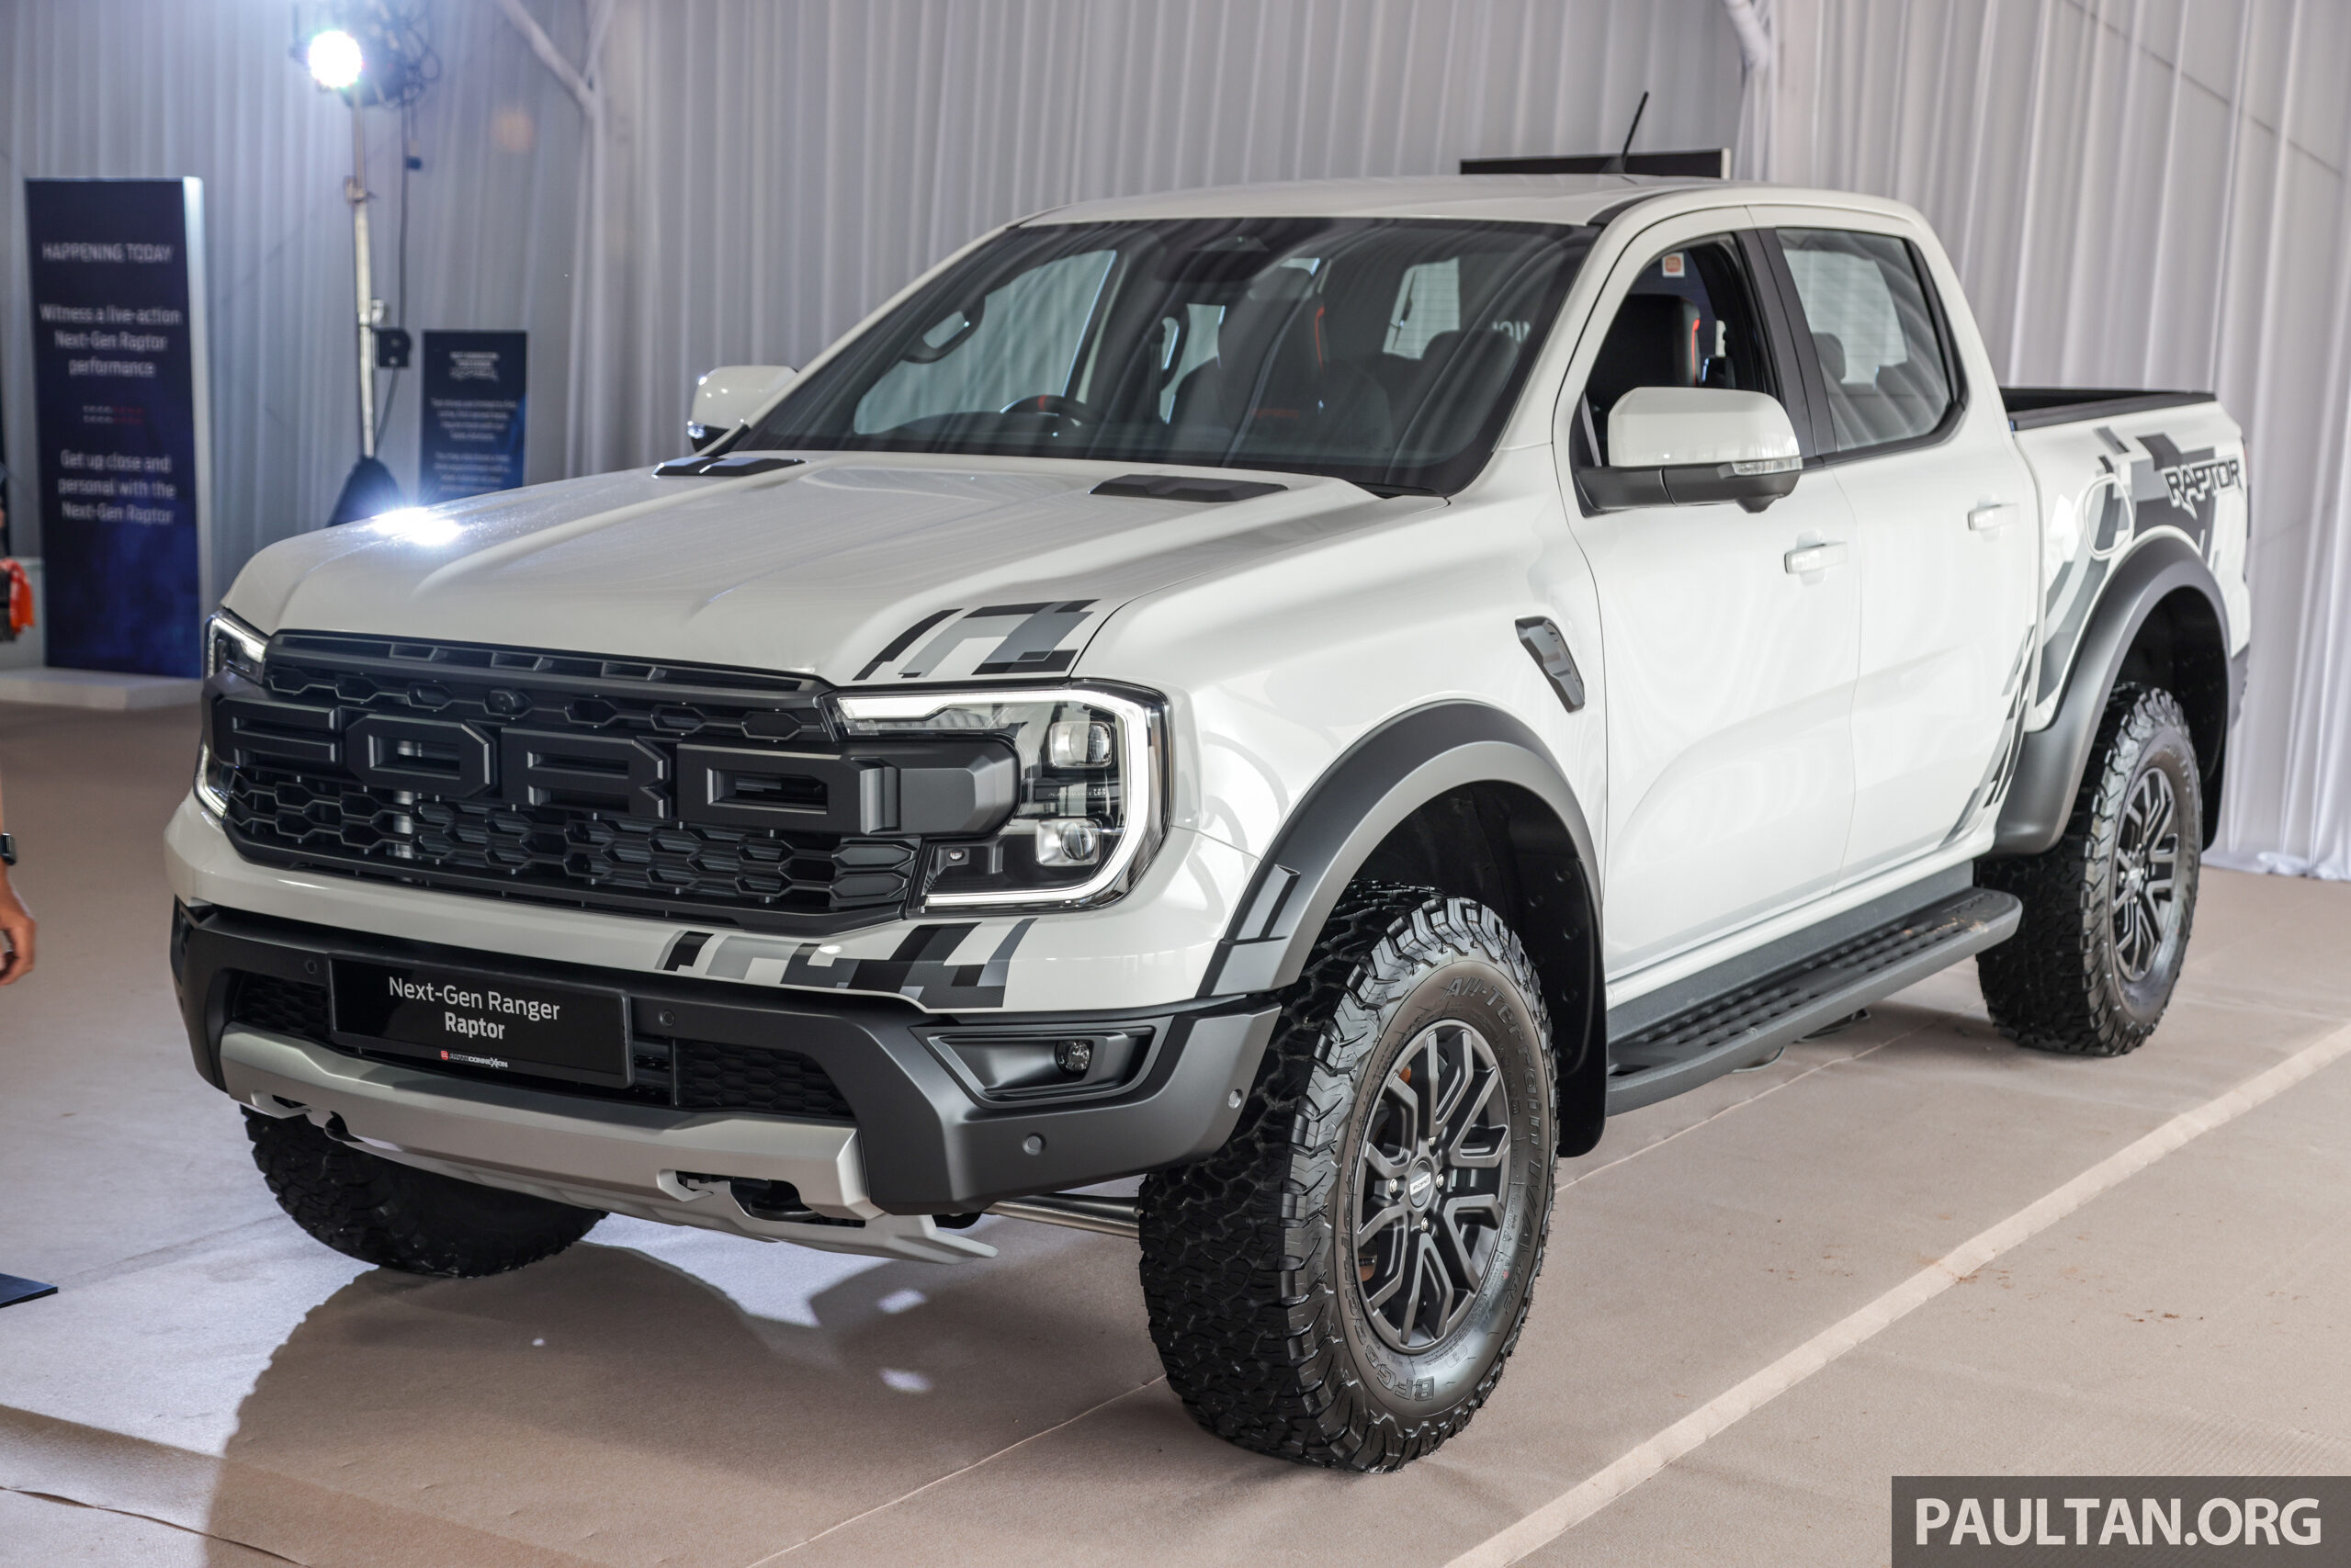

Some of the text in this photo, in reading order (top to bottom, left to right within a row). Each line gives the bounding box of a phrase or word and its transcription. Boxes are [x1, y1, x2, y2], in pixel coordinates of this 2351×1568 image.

[41, 242, 175, 264] HAPPENING TODAY
[39, 304, 183, 326] Witness a live-action
[54, 330, 169, 353] Next-Gen Raptor
[68, 355, 156, 378] performance
[60, 449, 173, 473] Get up close and
[58, 478, 177, 500] personal with the
[2162, 457, 2244, 520] RAPTOR
[61, 502, 175, 526] Next-Gen Raptor
[212, 696, 901, 835] FORD
[388, 976, 560, 1021] Next-Gen Ranger
[444, 1010, 505, 1040] Raptor
